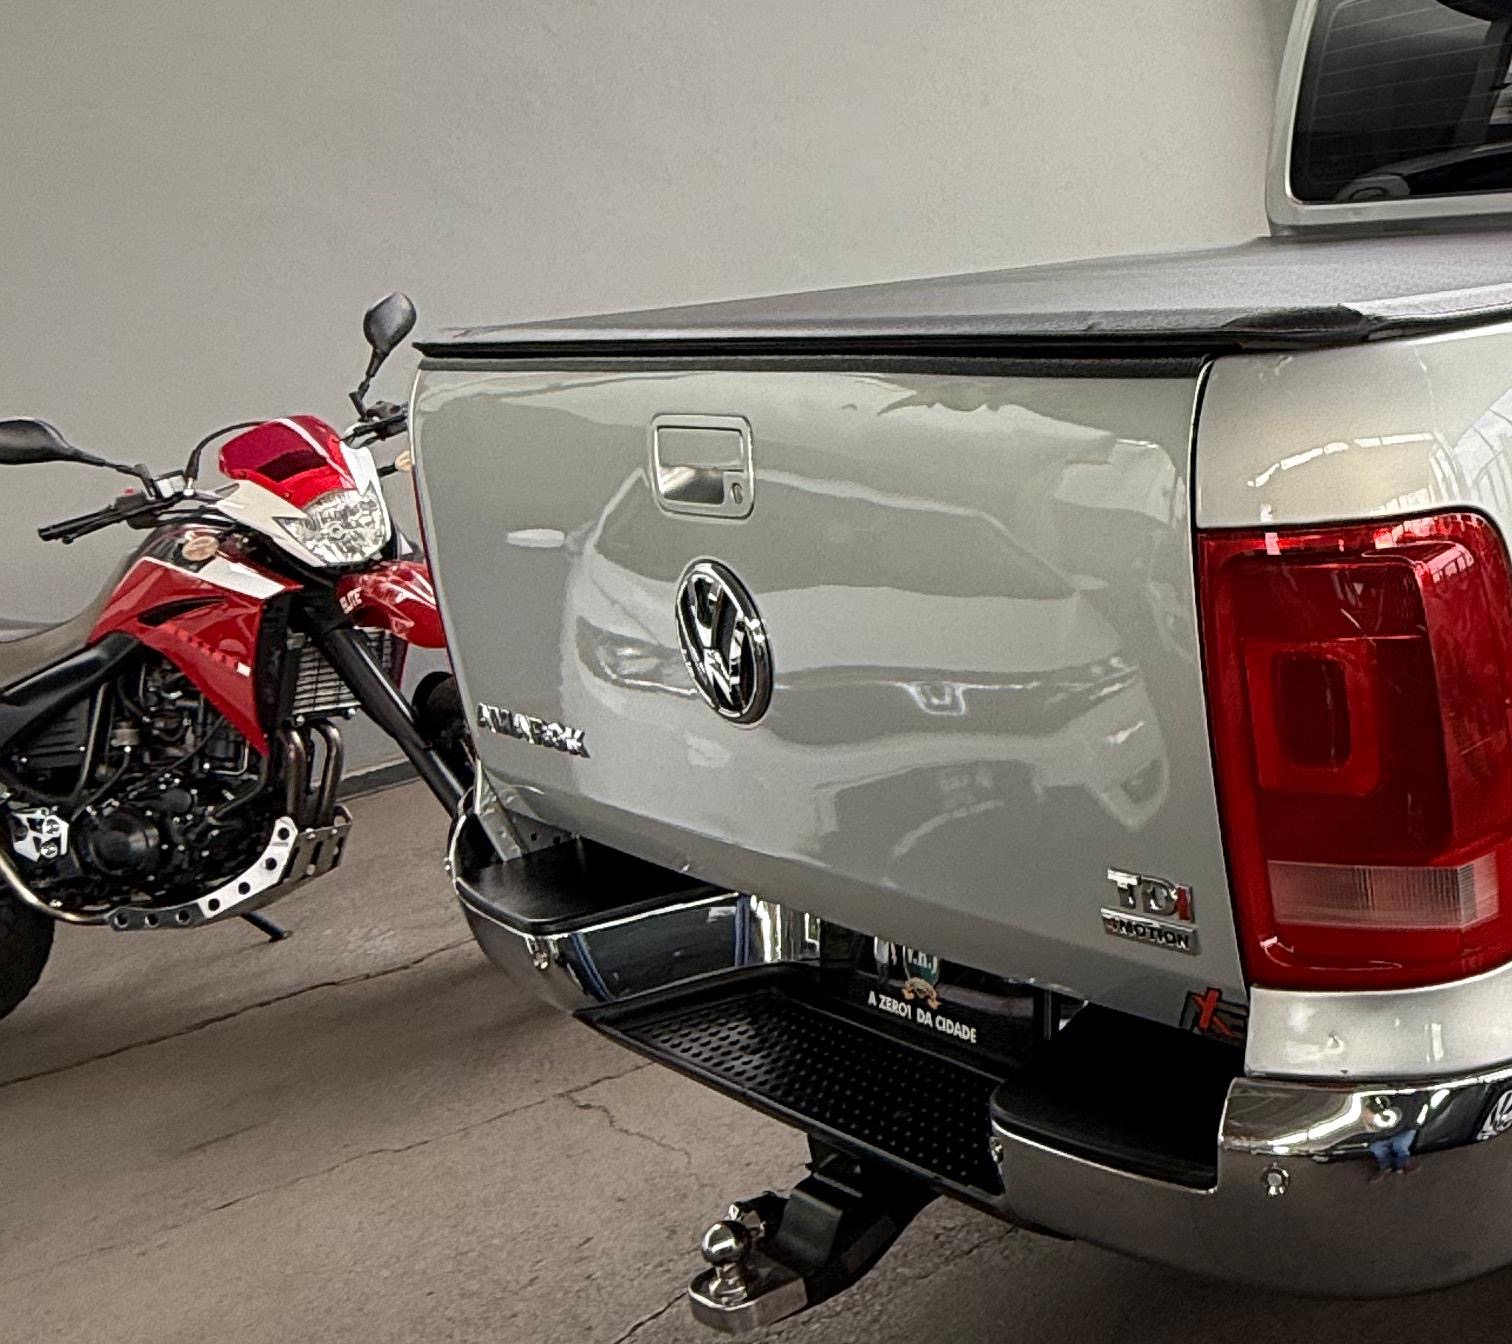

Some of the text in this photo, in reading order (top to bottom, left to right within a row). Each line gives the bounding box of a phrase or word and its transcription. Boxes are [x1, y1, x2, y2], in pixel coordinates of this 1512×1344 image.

[1106, 867, 1195, 923] TDI
[867, 990, 877, 1006] A
[916, 1008, 933, 1028] DA
[935, 1015, 977, 1044] CIDADE
